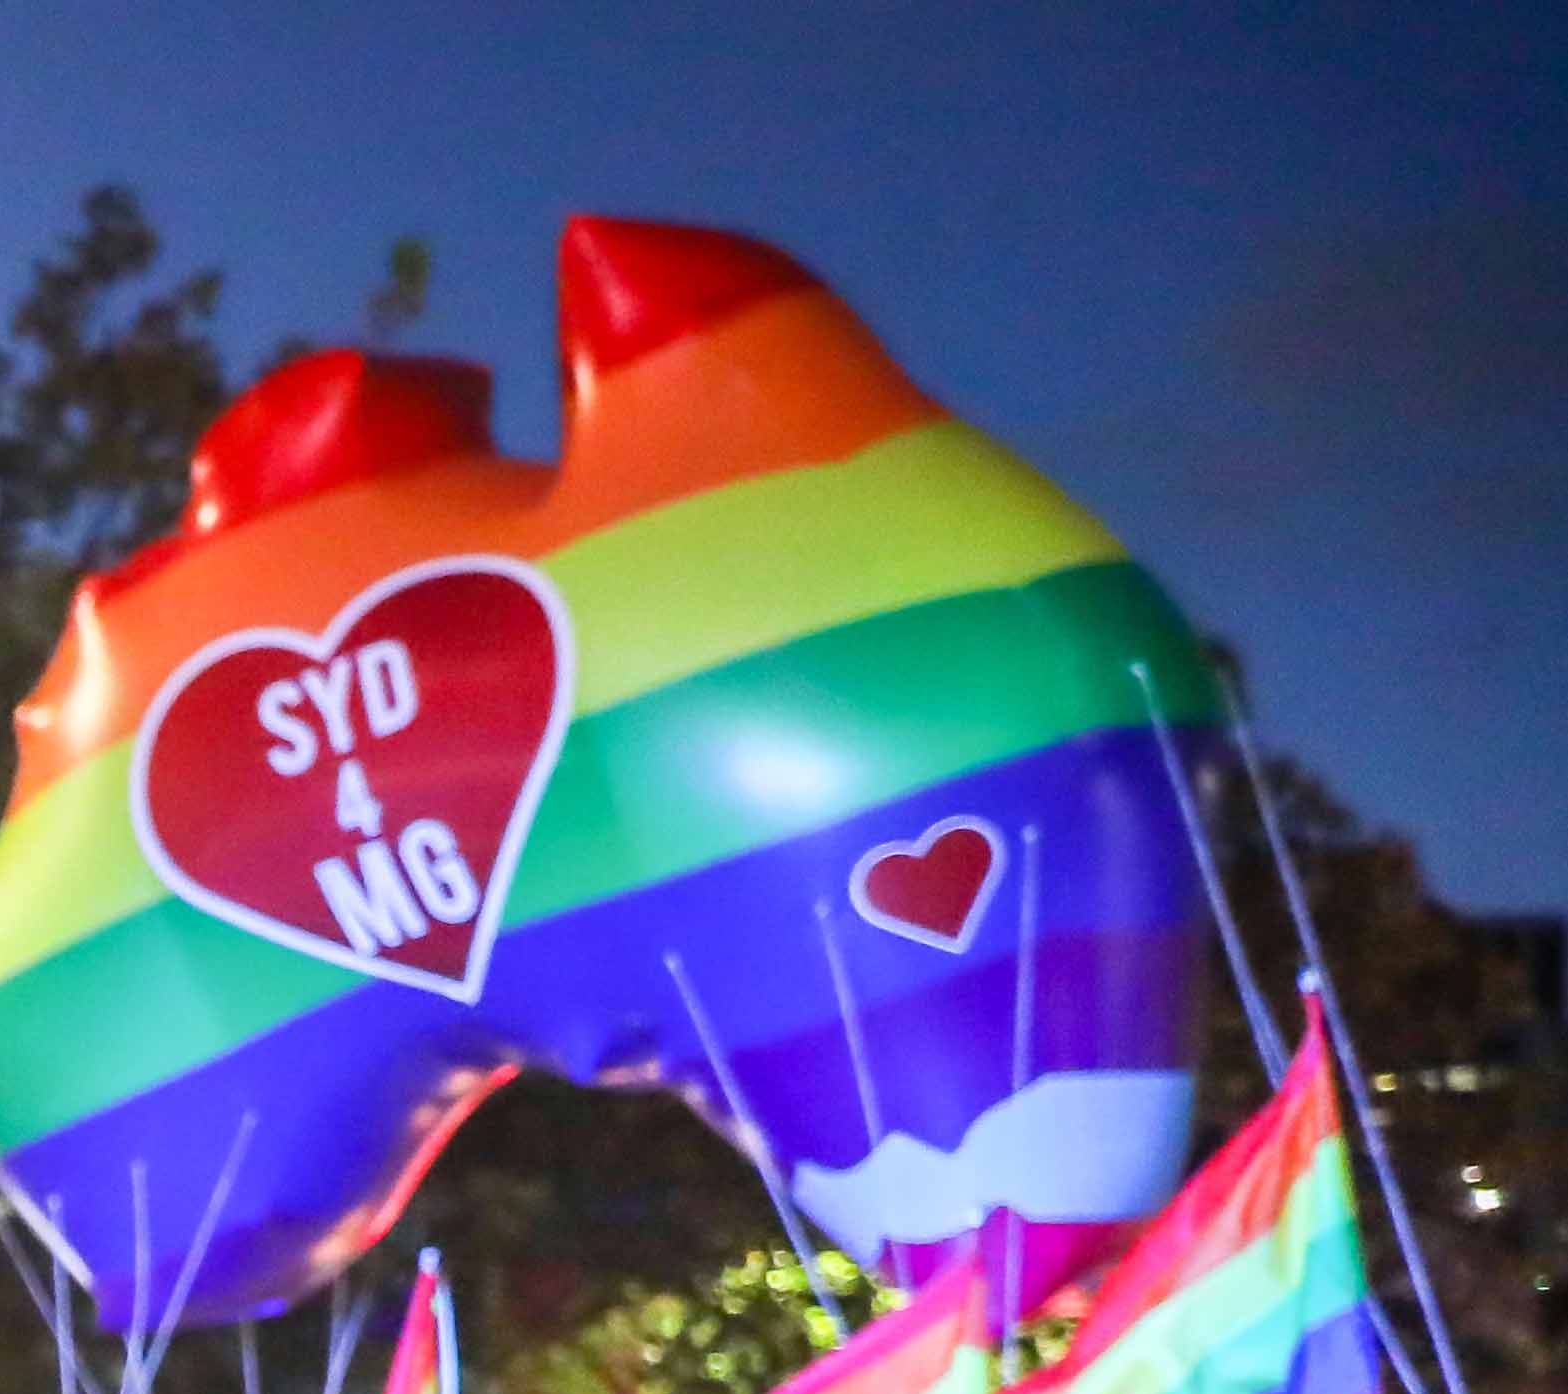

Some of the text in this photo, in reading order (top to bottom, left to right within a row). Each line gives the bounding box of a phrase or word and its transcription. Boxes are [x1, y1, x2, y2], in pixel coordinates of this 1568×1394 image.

[258, 639, 419, 776] SYD
[335, 758, 383, 838] 4
[312, 818, 481, 958] MG
